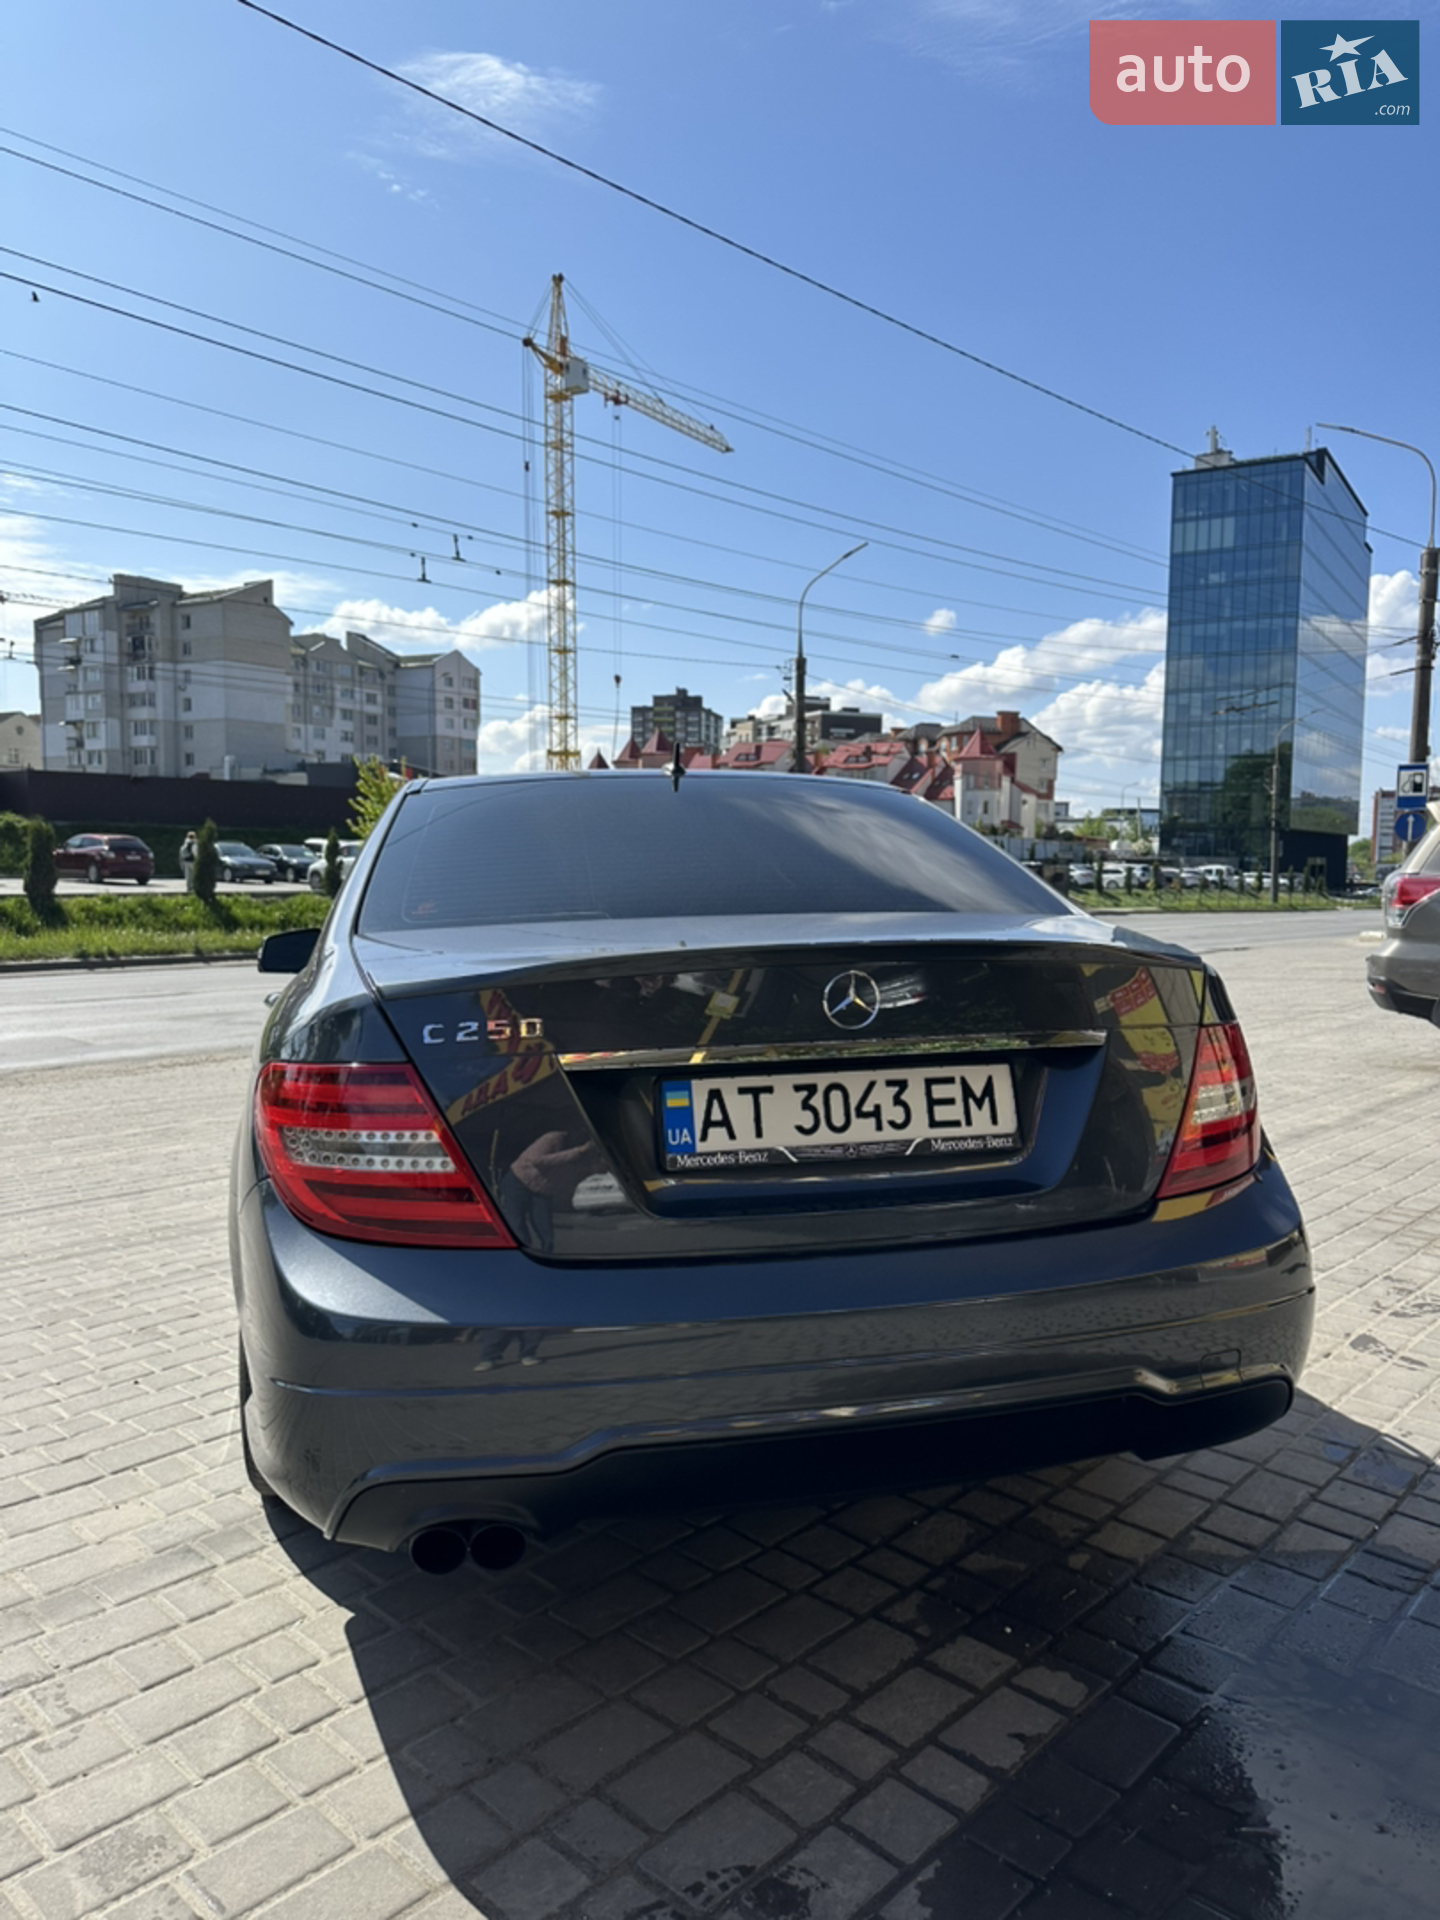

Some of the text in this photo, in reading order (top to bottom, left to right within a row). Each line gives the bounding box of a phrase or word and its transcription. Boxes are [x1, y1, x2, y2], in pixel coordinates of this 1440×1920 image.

[422, 1017, 543, 1044] C 250
[699, 1074, 998, 1142] AT 3043 EM
[667, 1127, 692, 1145] UA
